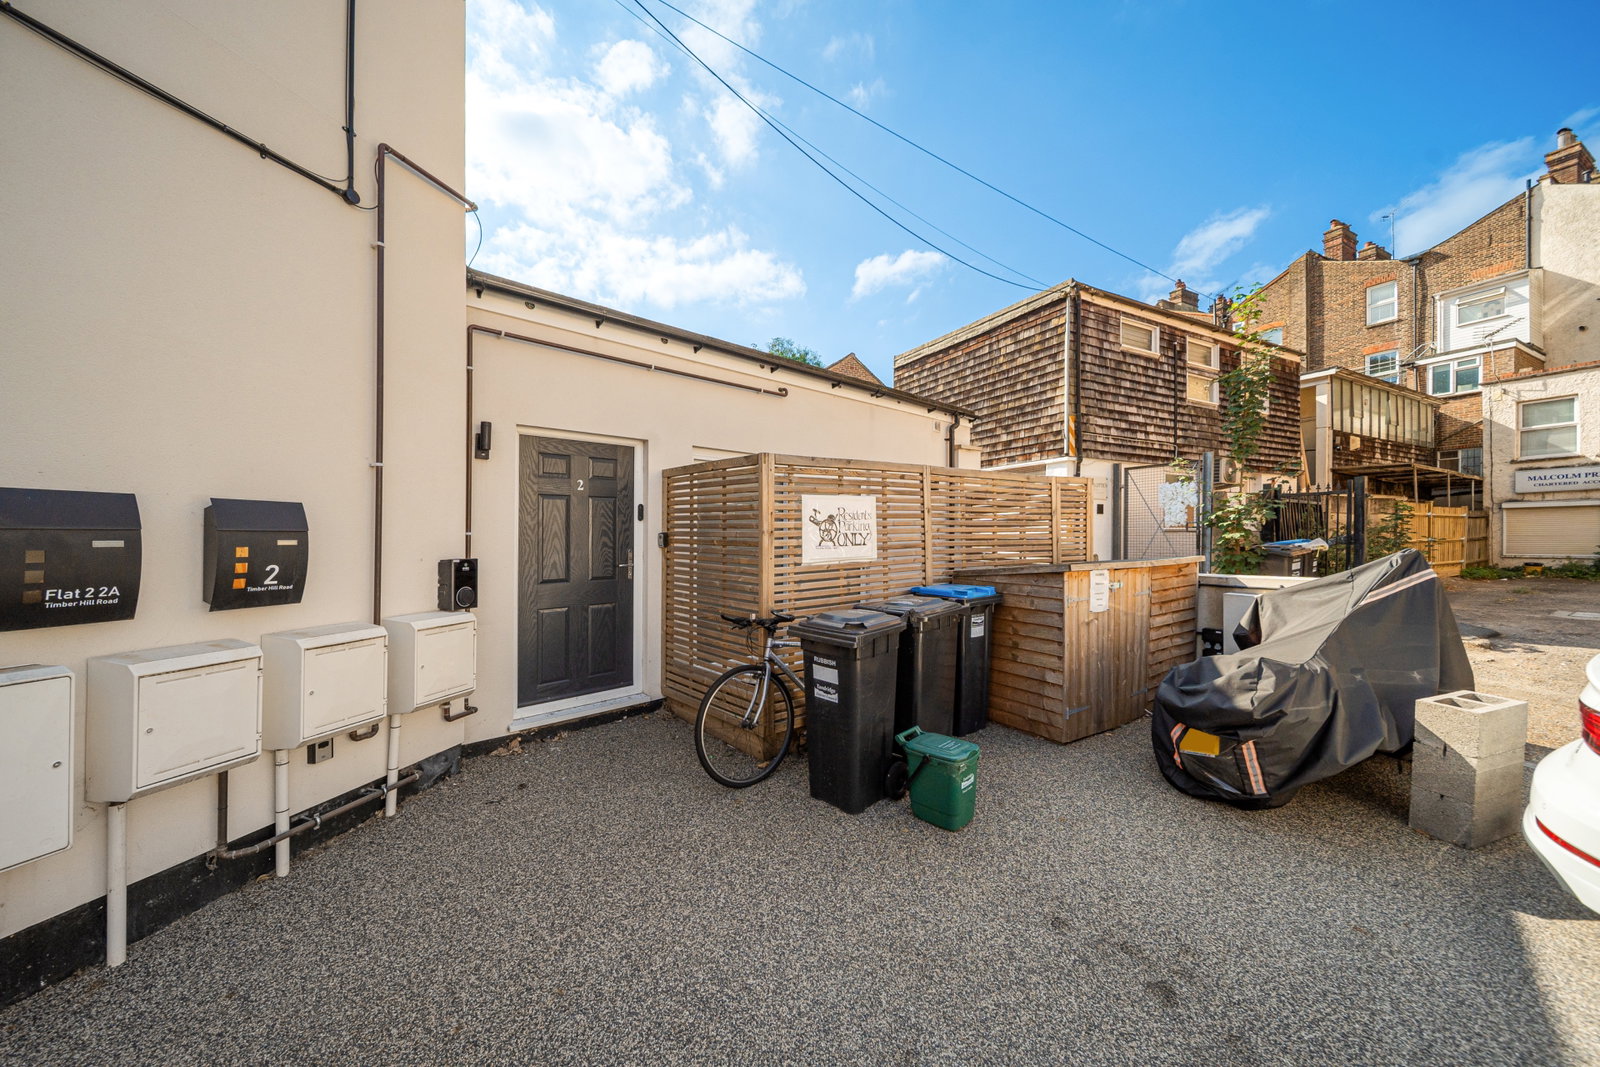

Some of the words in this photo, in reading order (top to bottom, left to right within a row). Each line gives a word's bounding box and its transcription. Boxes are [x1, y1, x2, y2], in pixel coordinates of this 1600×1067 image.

[1527, 472, 1581, 482] MALCOLM
[576, 479, 585, 491] 2
[837, 532, 870, 547] ONLY
[264, 564, 280, 585] 2
[45, 588, 81, 601] Flat
[84, 587, 95, 598] 2
[98, 585, 120, 597] 2A
[44, 601, 78, 609] Timber
[813, 655, 837, 667] RUBBISH
